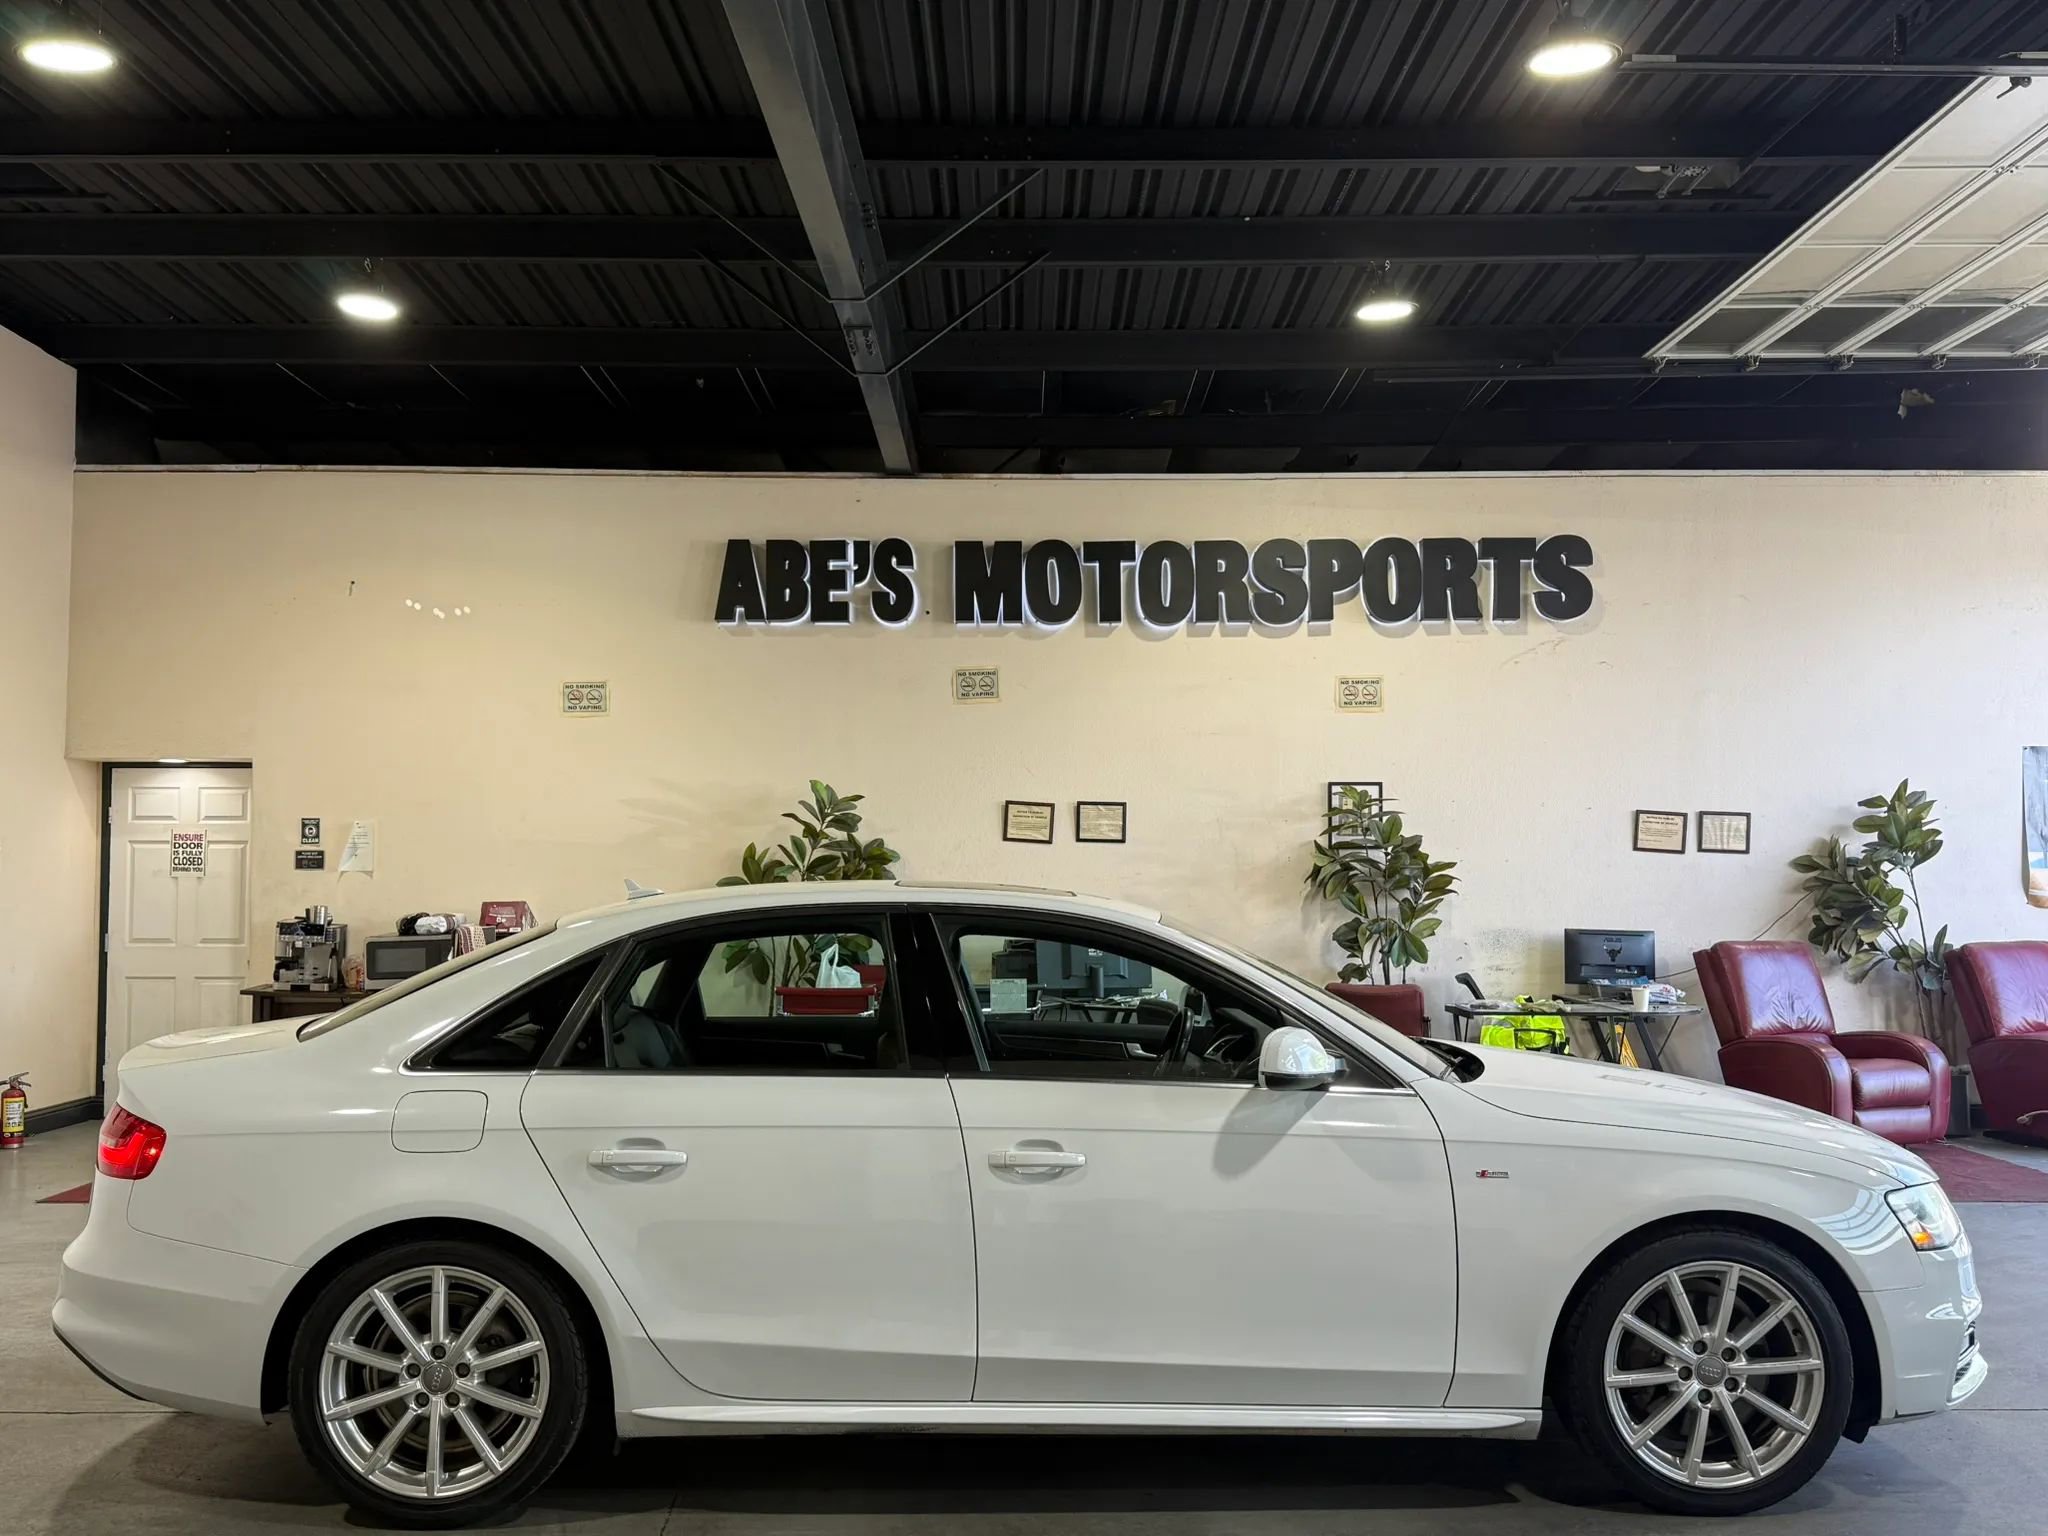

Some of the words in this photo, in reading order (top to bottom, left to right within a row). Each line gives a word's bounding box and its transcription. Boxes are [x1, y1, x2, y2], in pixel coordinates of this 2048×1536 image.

[715, 537, 916, 624] ABE'S
[954, 536, 1594, 627] MOTORSPORTS
[173, 833, 204, 842] ENSURE
[173, 842, 203, 850] DOOR
[172, 856, 203, 866] CLOSED
